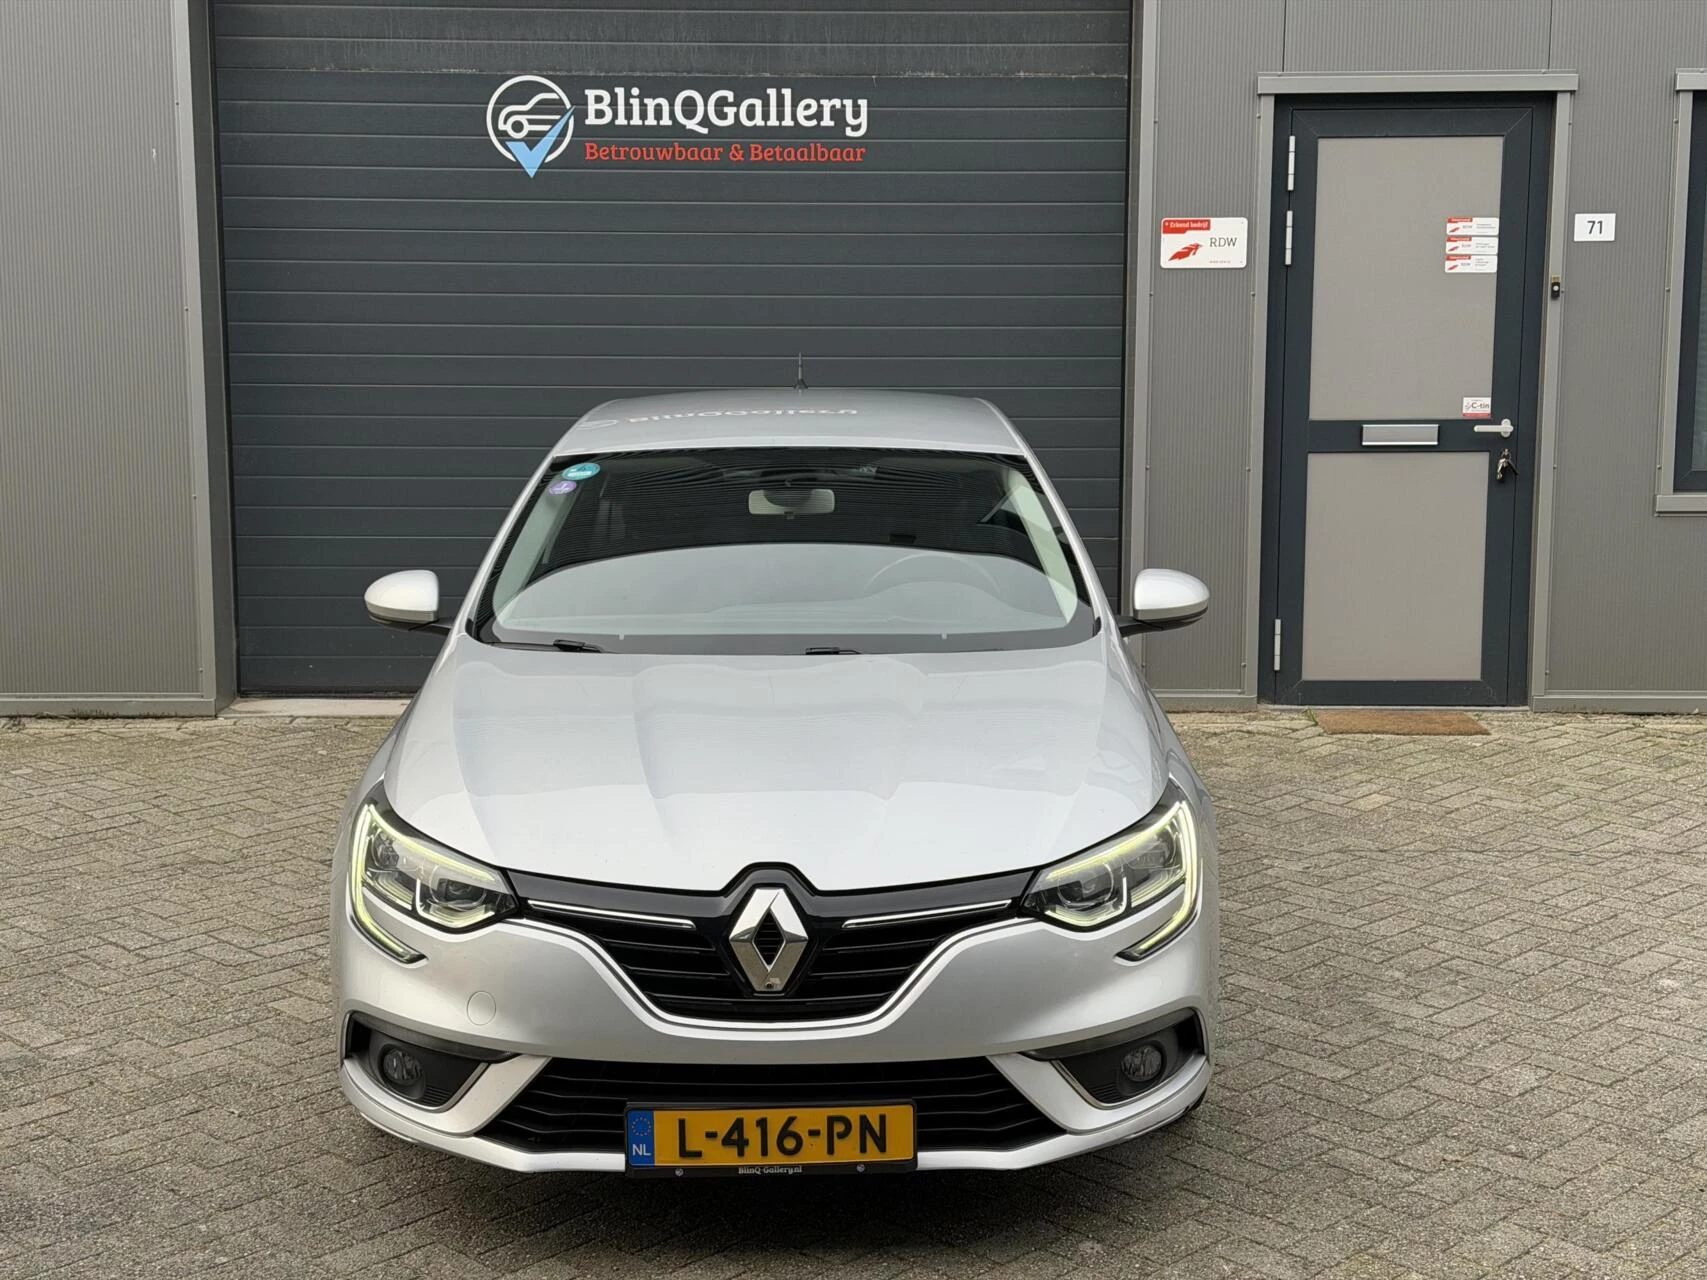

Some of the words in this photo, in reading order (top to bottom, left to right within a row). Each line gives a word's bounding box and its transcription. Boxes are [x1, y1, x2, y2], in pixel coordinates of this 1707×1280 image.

[584, 87, 868, 137] BlinQGallery
[584, 142, 723, 161] Betrouwbaar
[728, 143, 744, 161] &
[749, 142, 866, 161] Betaalbaar
[1587, 220, 1603, 234] 71
[1209, 237, 1238, 247] RDW
[678, 1114, 887, 1158] L-416-PN
[632, 1143, 651, 1156] NL
